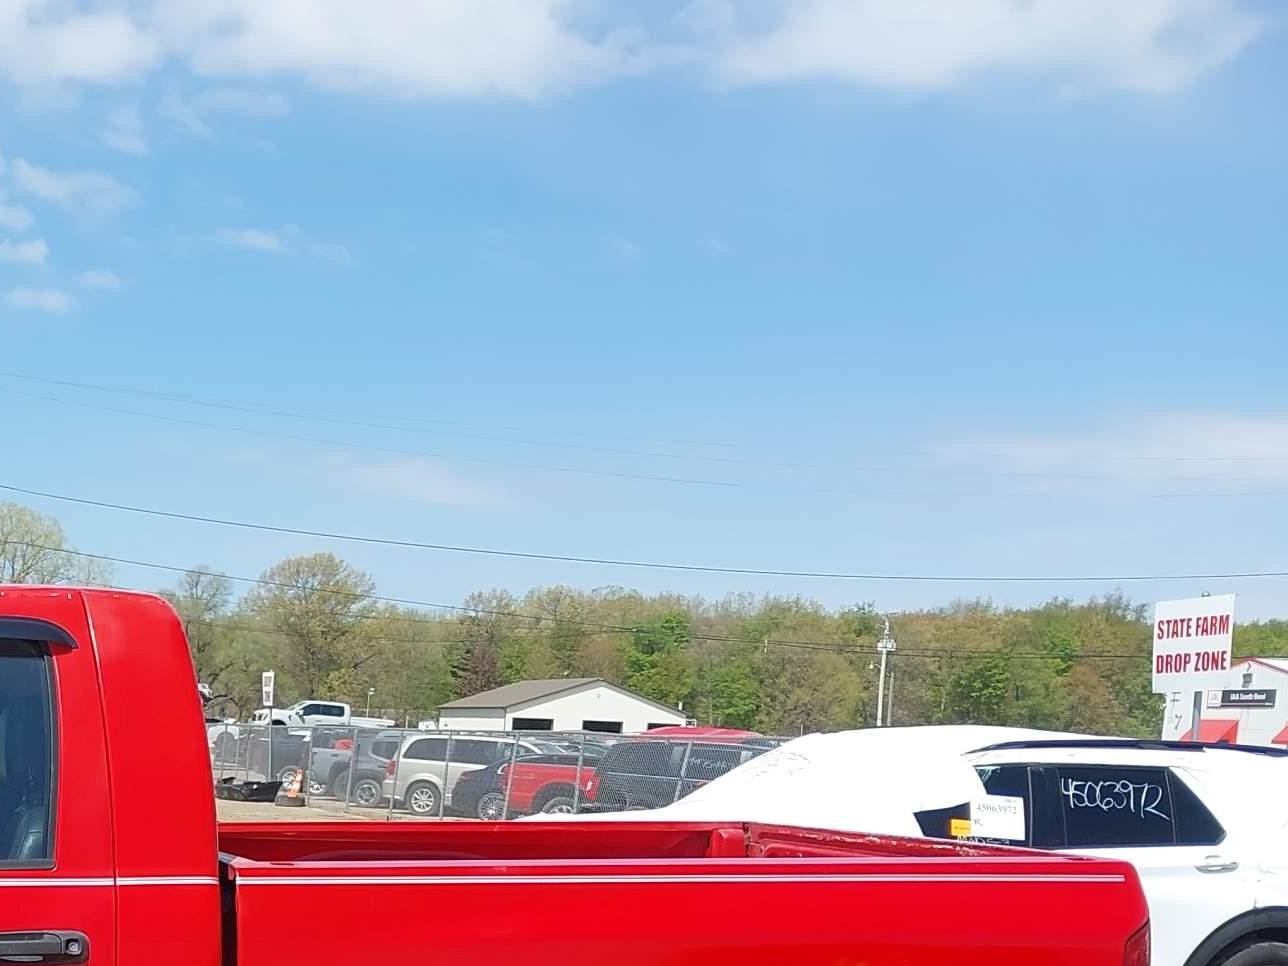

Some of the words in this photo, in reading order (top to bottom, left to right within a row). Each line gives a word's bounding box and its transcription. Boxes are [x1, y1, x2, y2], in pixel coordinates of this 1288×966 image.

[1157, 617, 1193, 640] STATE
[1195, 614, 1231, 637] FARM
[1155, 653, 1192, 674] DROP
[1193, 650, 1228, 673] ZONE
